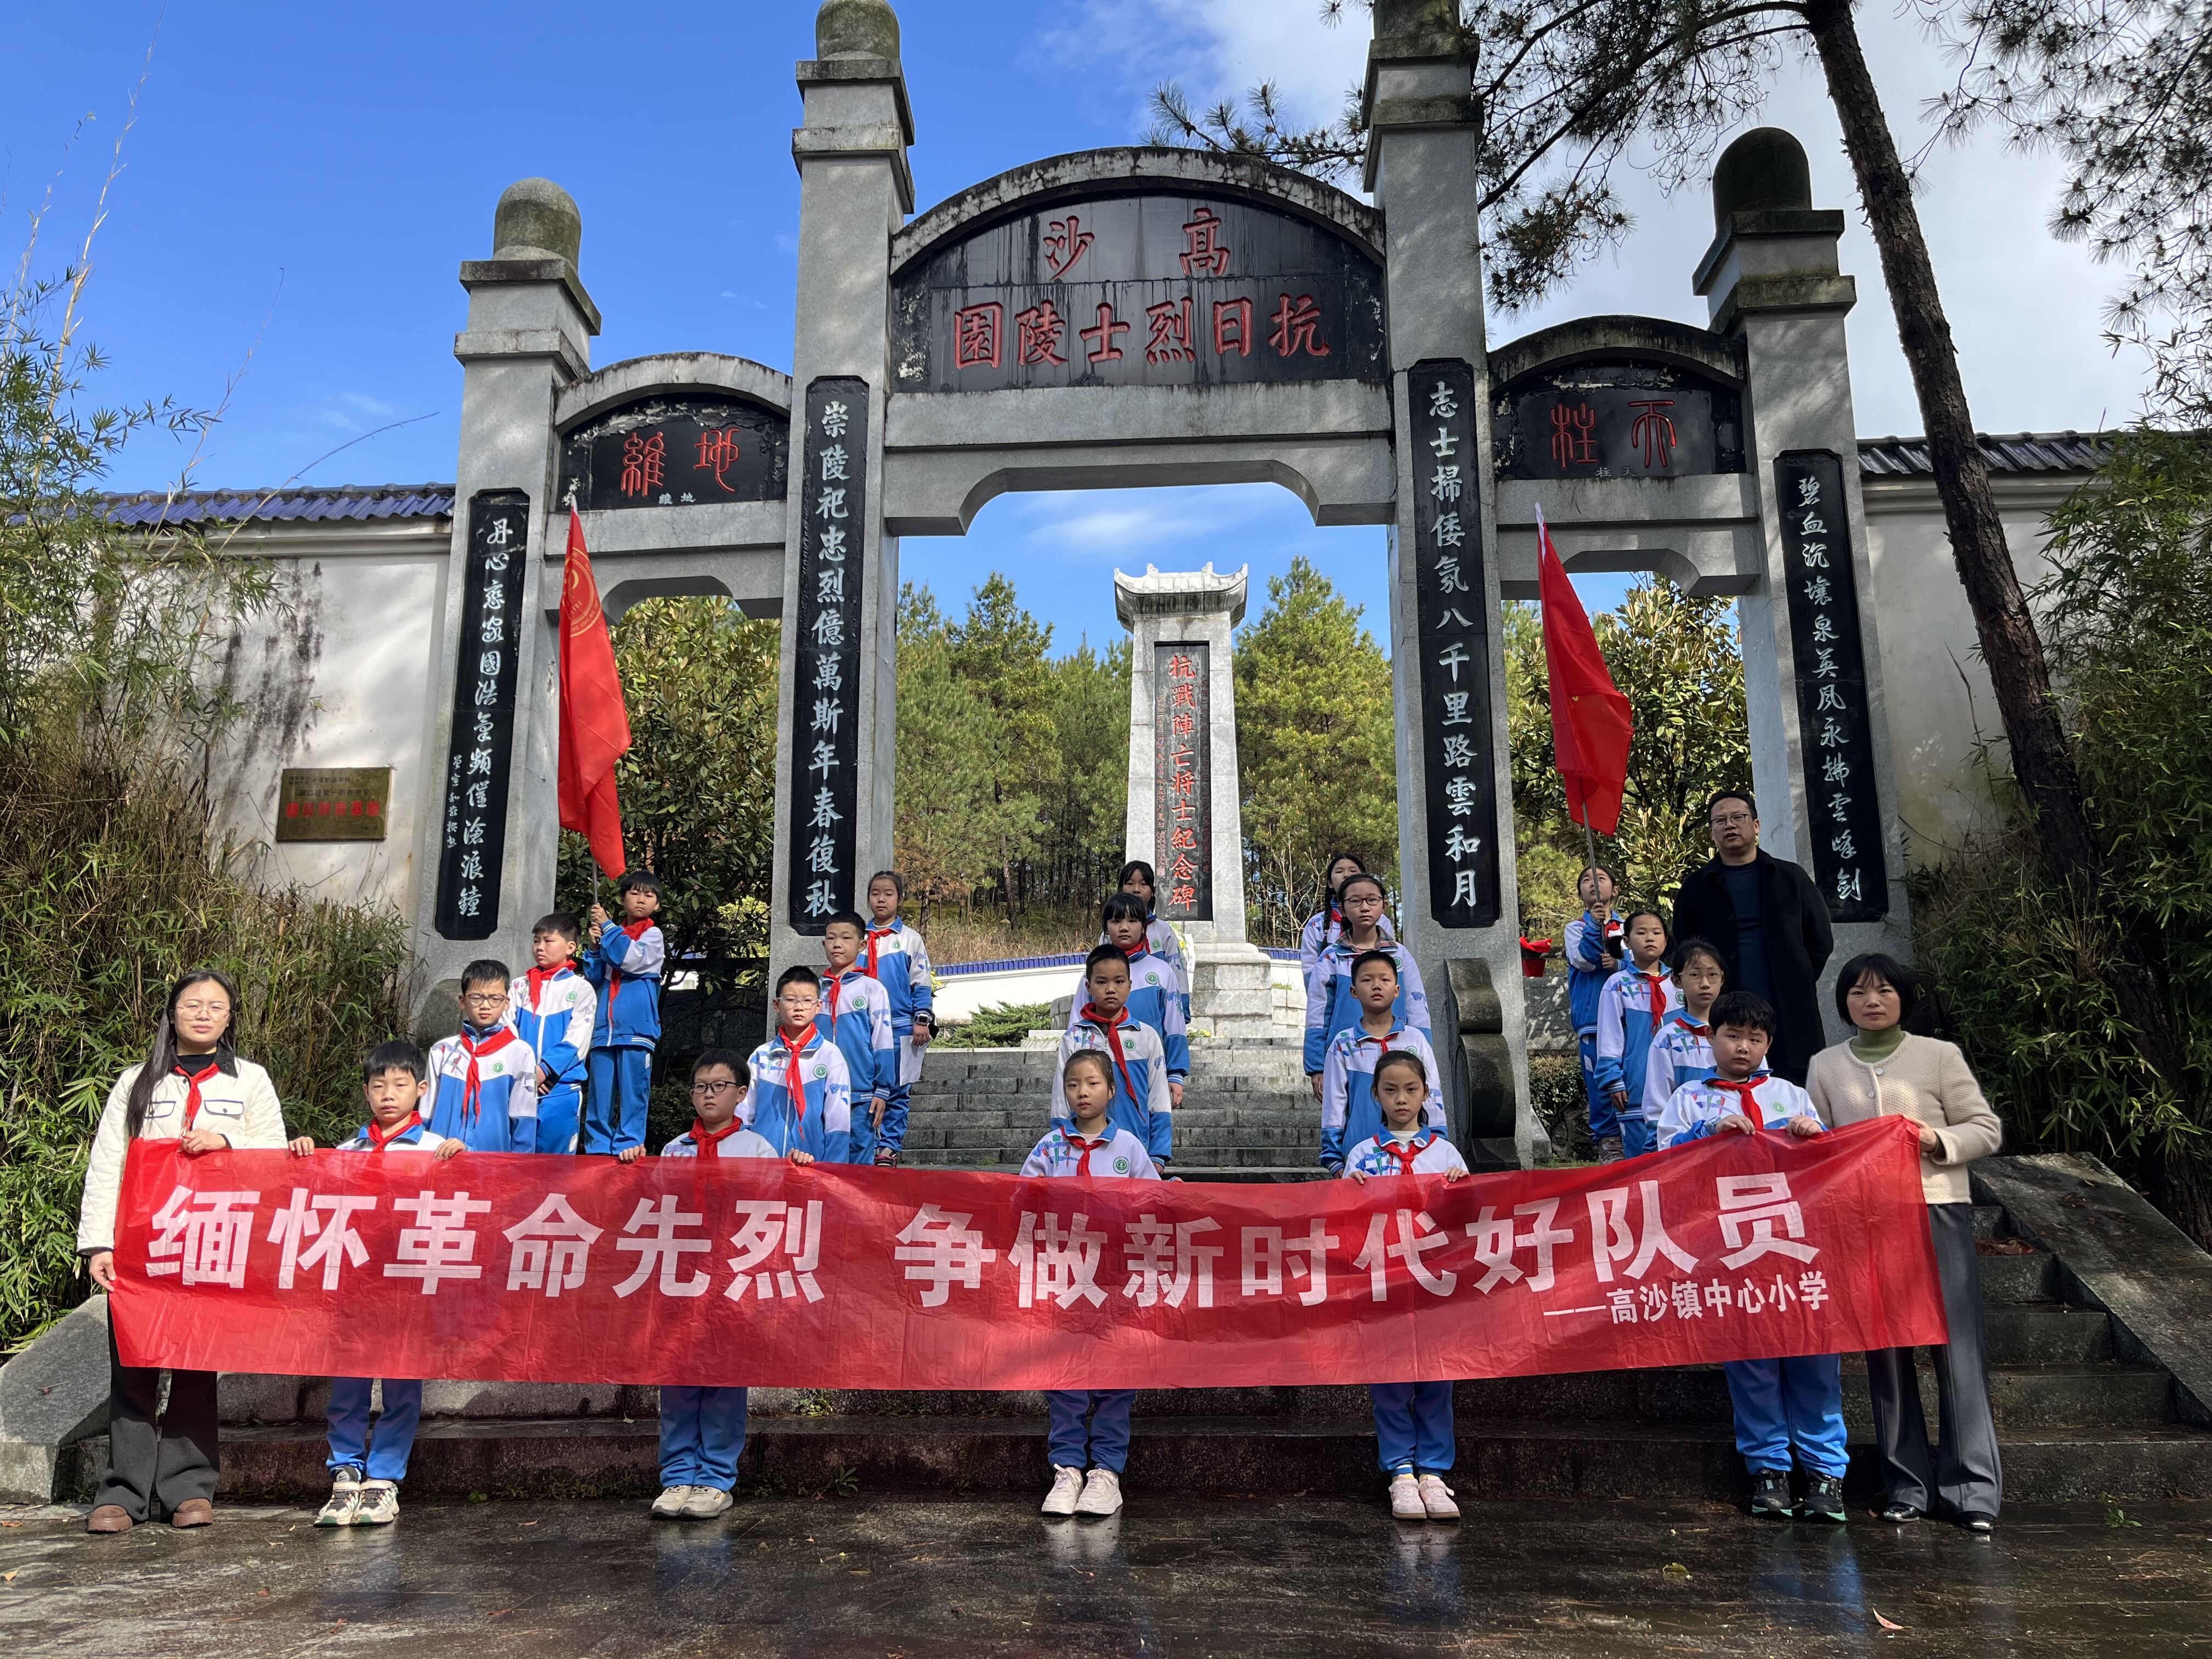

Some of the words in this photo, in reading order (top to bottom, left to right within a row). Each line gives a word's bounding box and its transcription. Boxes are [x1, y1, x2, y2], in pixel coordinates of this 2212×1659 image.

[953, 292, 1332, 370] 抗日烈士陵園
[1595, 465, 1637, 477] 天柱
[804, 400, 850, 918] 崇陵祀忠烈億萬斯年春復秋
[1429, 380, 1480, 907] 志士掃倭氛八千里路雲和月
[145, 1184, 825, 1304] 缅怀革命先烈
[894, 1171, 1820, 1309] 争做新时代好队员
